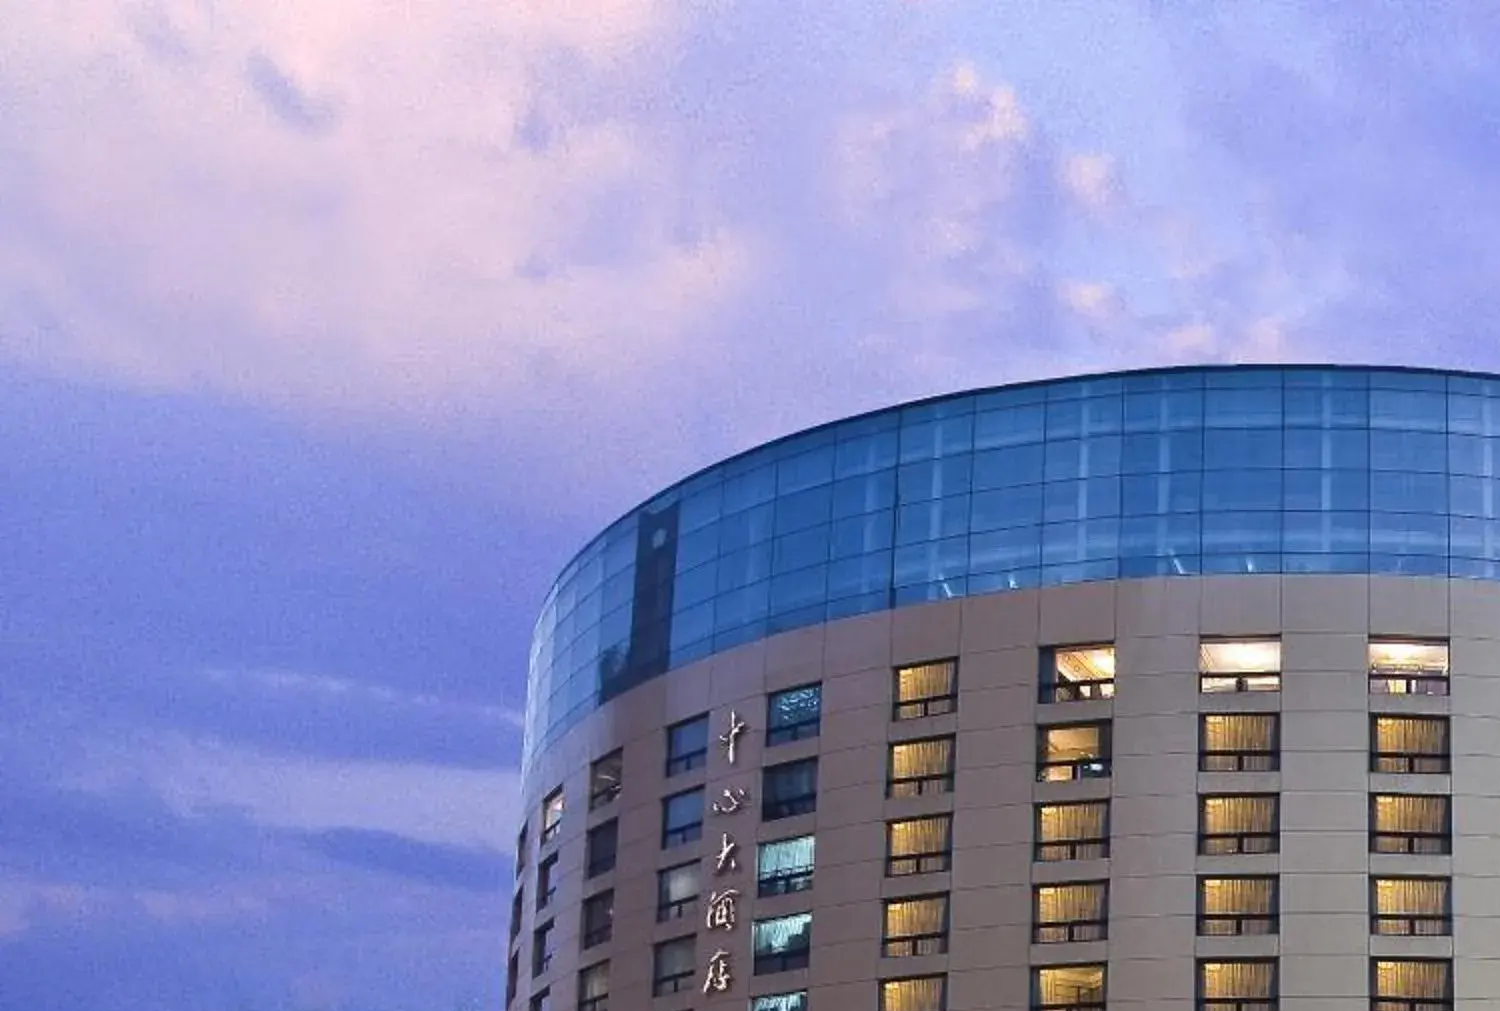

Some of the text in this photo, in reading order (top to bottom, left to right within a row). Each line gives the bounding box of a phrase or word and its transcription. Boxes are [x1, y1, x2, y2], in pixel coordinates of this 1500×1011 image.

[703, 711, 746, 994] 中心大酒店
